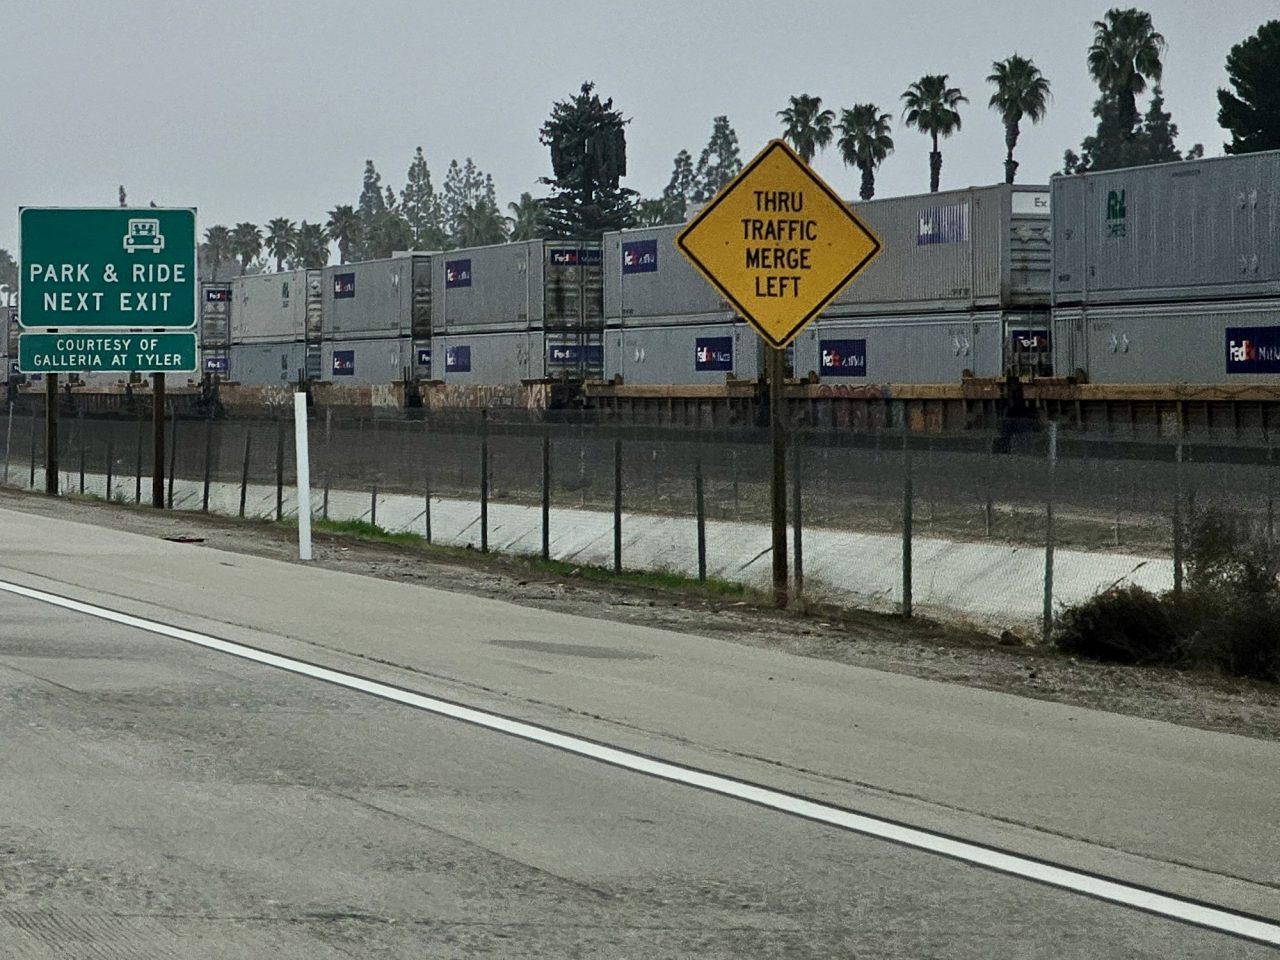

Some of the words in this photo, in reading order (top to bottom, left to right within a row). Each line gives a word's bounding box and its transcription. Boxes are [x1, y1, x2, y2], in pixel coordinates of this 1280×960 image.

[753, 191, 803, 212] THRU
[741, 219, 817, 240] TRAFFIC
[746, 248, 811, 269] MERGE
[30, 264, 90, 282] PARK
[103, 264, 119, 282] &
[133, 264, 186, 282] RIDE
[755, 276, 801, 297] LEFT
[44, 293, 104, 311] NEXT
[120, 293, 171, 311] EXIT
[57, 339, 131, 350] COURTESY
[140, 339, 158, 350] OF
[34, 354, 101, 366] GALLERIA
[111, 354, 127, 366] AT
[136, 354, 182, 366] TYLER
